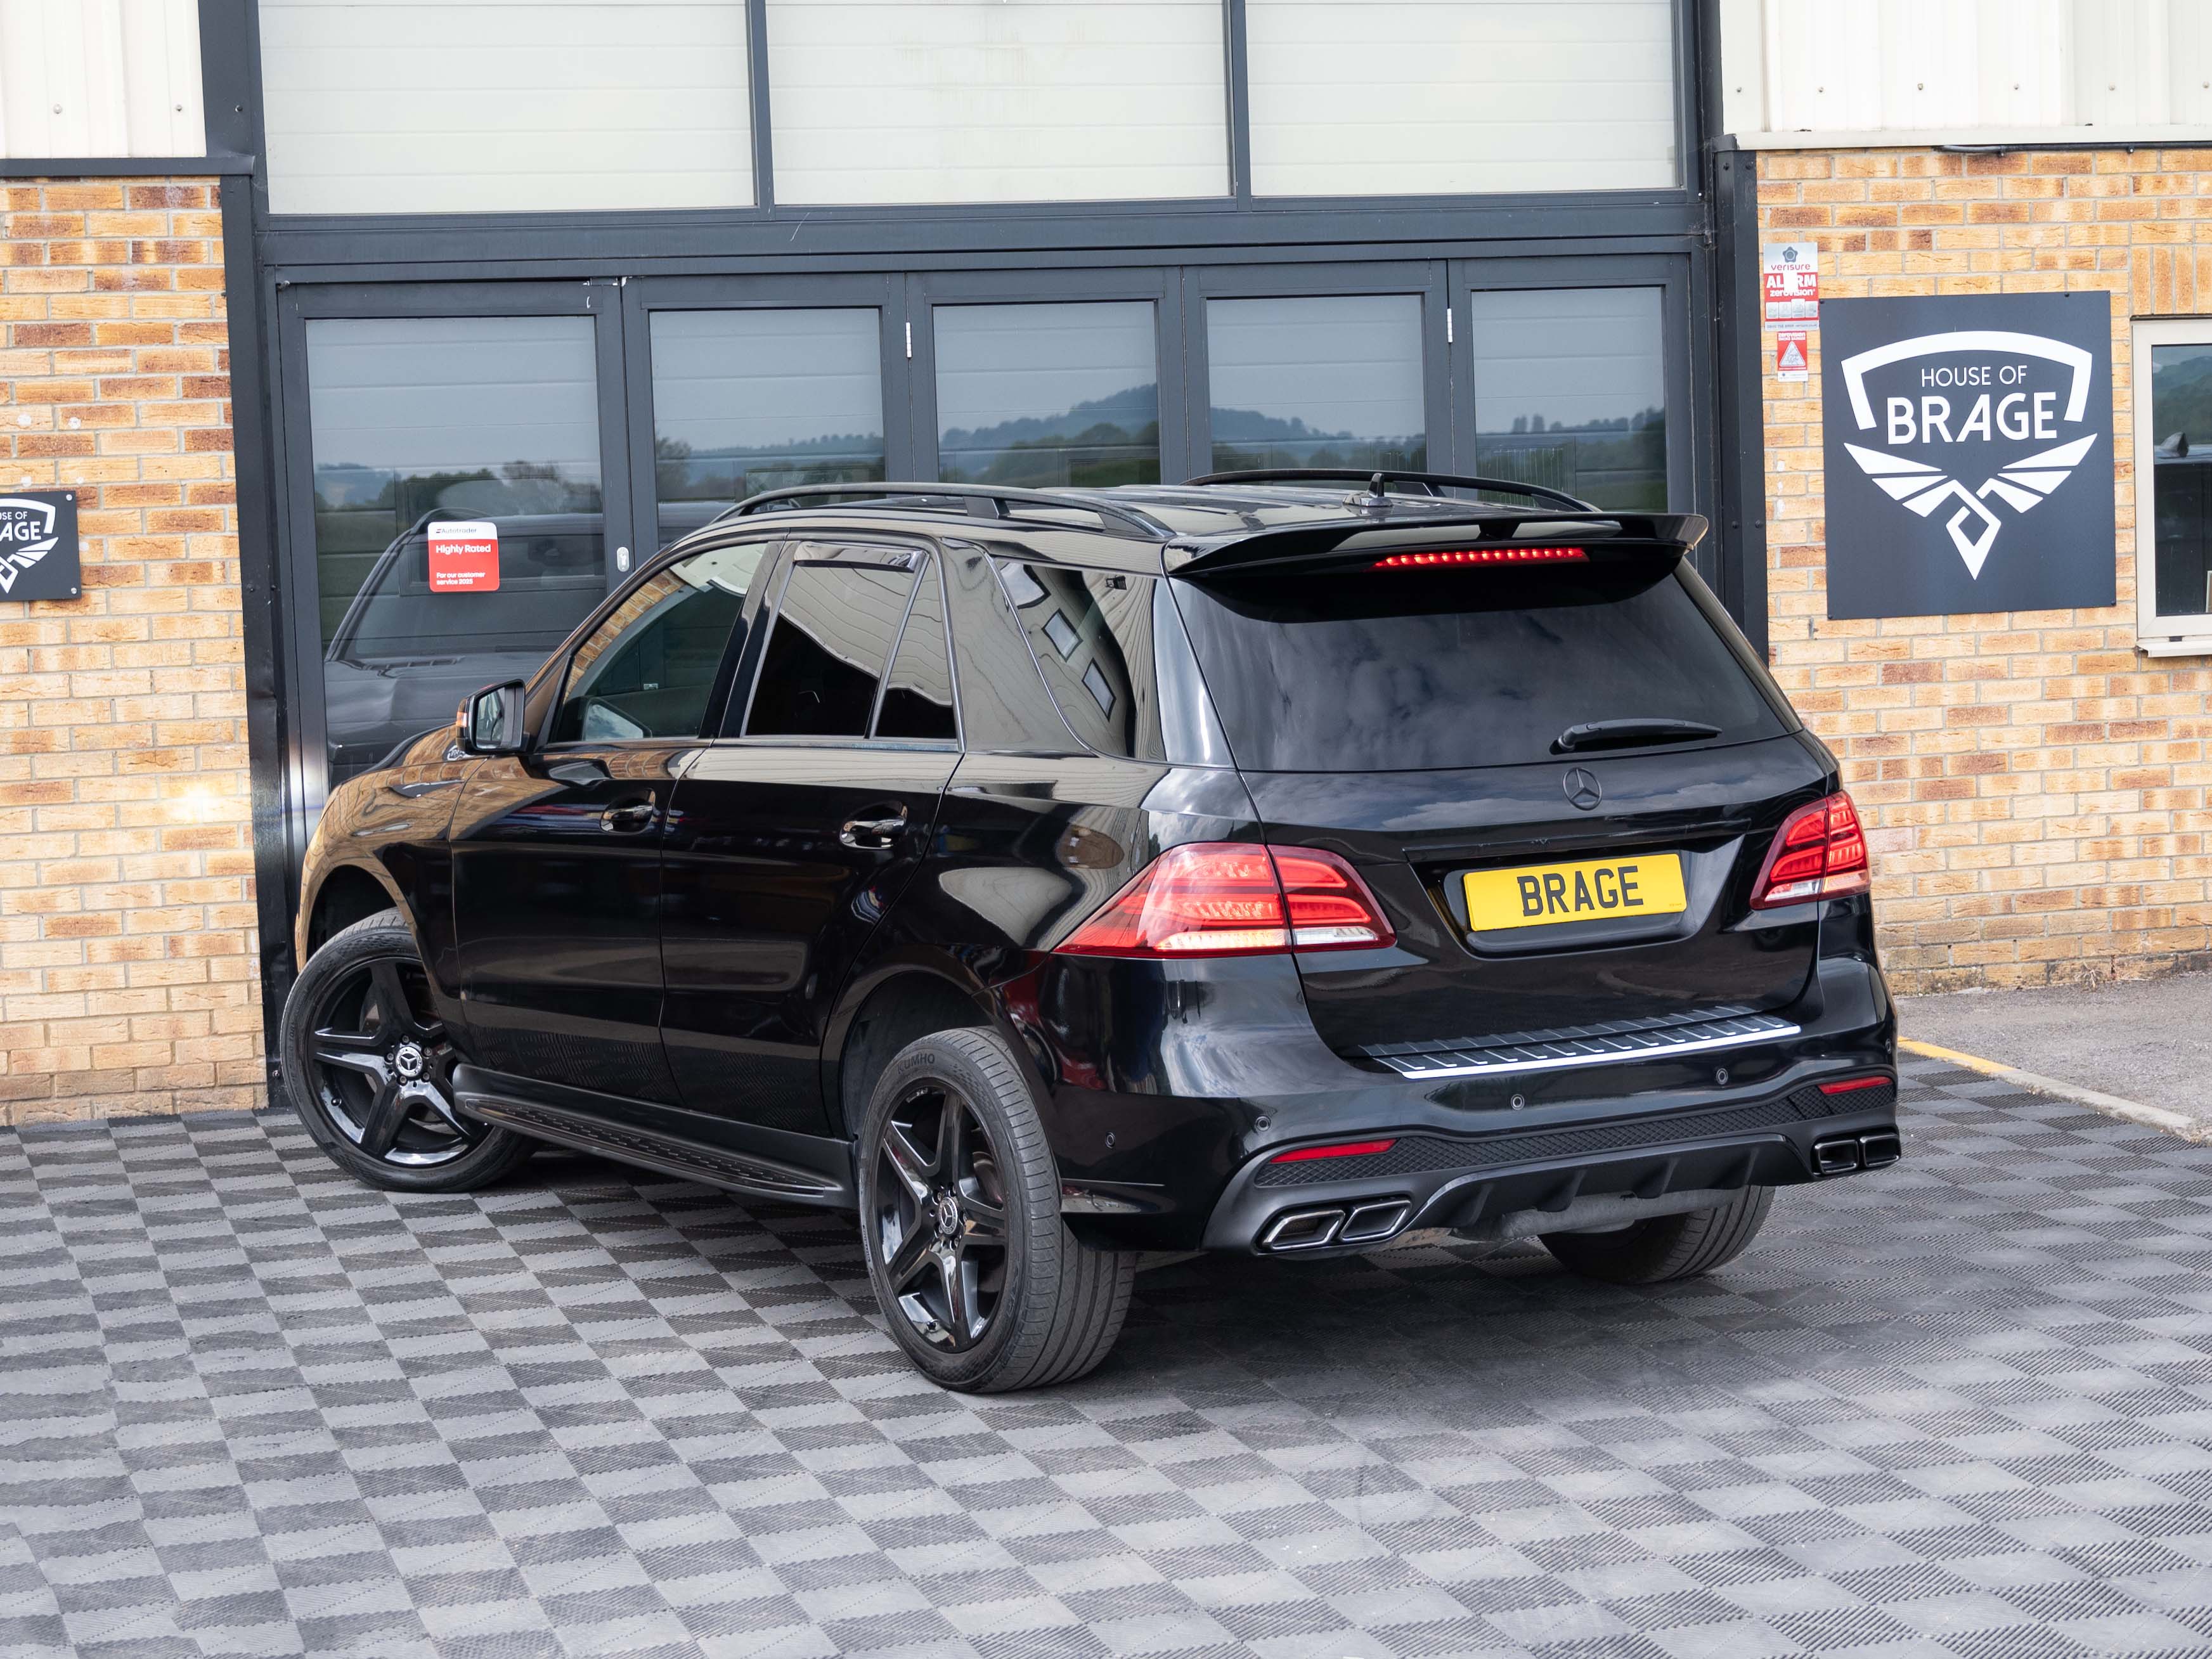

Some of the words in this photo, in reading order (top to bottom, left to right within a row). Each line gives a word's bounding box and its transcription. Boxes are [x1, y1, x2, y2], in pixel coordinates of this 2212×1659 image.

[1766, 274, 1817, 288] ALRM
[1921, 366, 1991, 387] HOUSE
[1999, 365, 2028, 385] OF
[1887, 391, 2057, 444] BRAGE
[15, 511, 28, 520] OF
[436, 544, 463, 555] Highly
[465, 544, 491, 553] Rated
[1516, 865, 1644, 917] BRAGE
[897, 1053, 936, 1076] KUMHO
